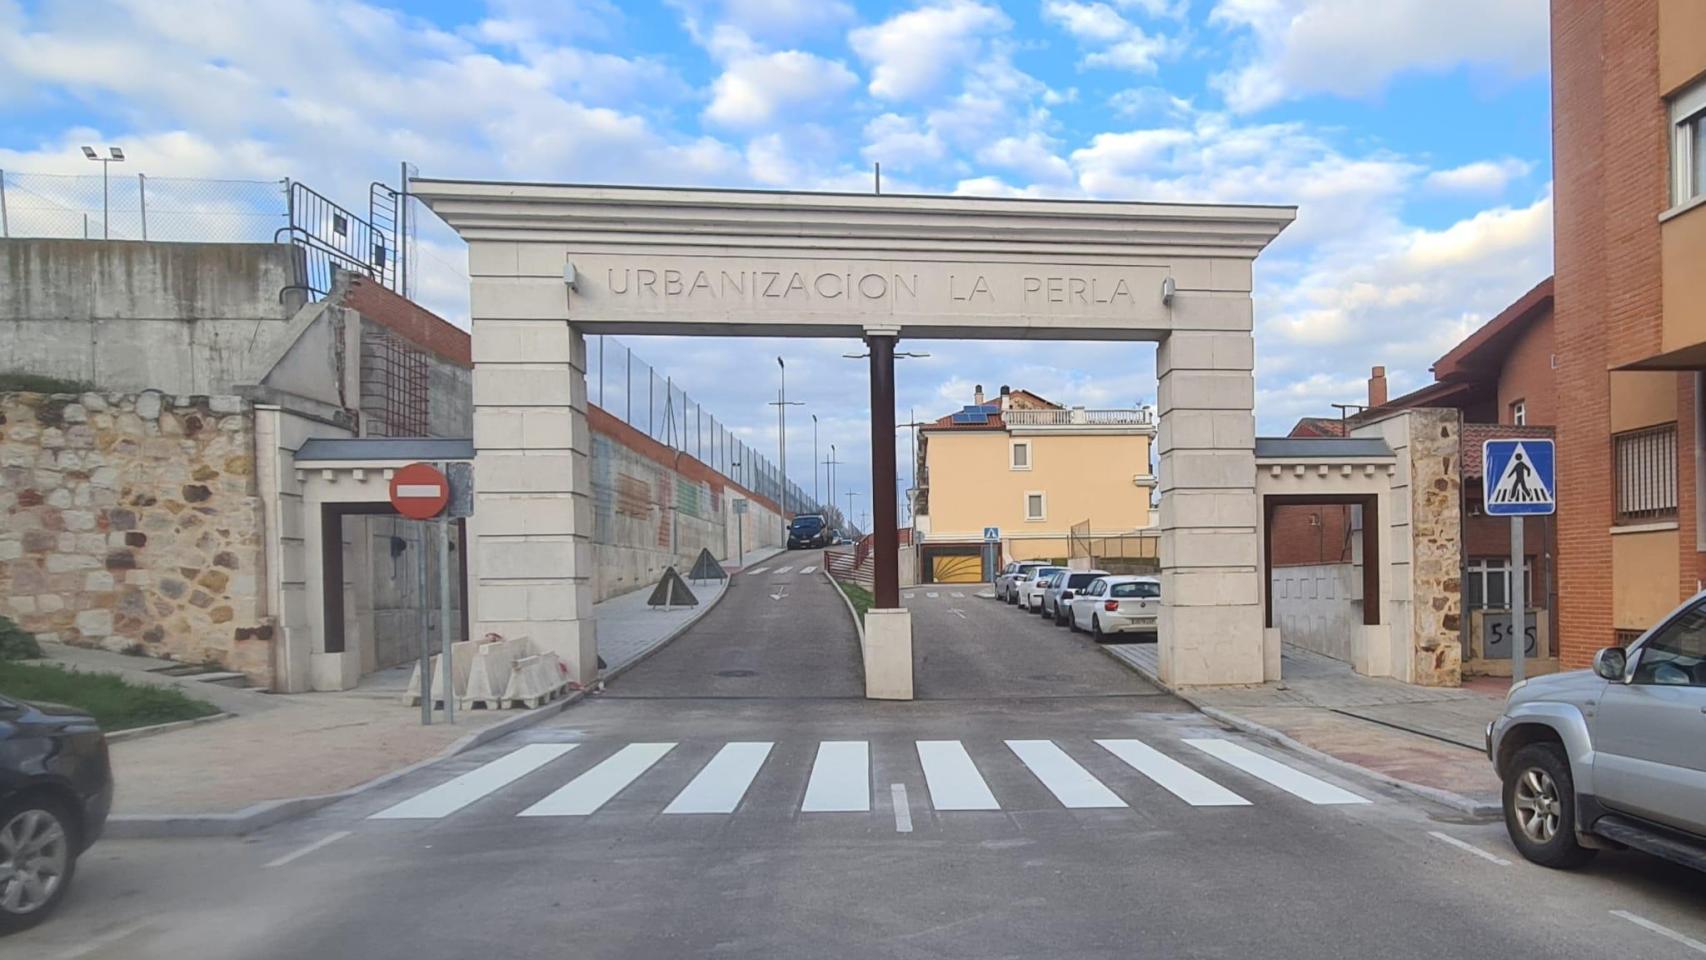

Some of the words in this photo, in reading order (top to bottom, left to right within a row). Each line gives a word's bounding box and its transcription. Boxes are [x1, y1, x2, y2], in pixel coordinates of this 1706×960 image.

[608, 268, 918, 300] URBANIZACION
[950, 275, 996, 302] LA
[1023, 277, 1136, 305] PERLA
